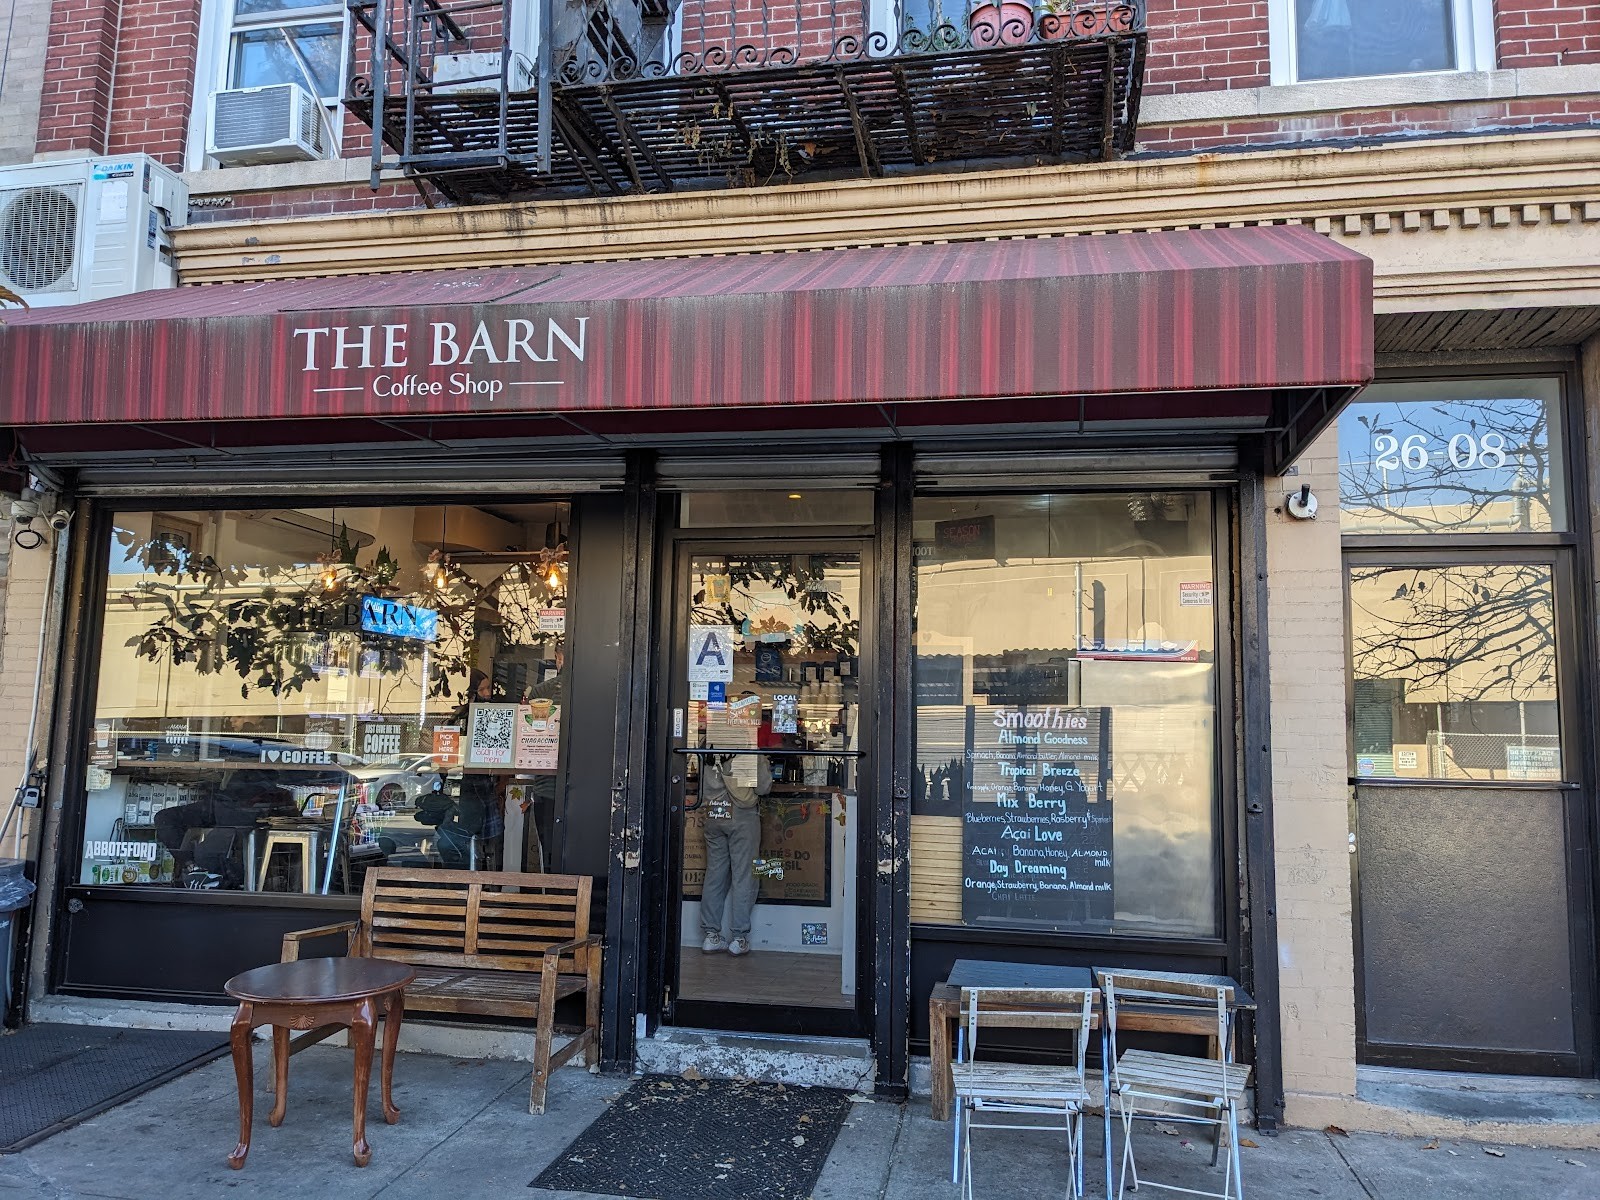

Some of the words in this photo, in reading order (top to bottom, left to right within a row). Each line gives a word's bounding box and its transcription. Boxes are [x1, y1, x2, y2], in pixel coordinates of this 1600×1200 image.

[101, 163, 133, 171] DAIKIN
[293, 323, 408, 371] THE
[429, 317, 590, 366] BARN
[372, 374, 443, 397] Coffee
[448, 372, 503, 402] Shop
[1374, 433, 1506, 471] 26-08
[343, 602, 418, 626] BARN
[695, 631, 726, 666] A
[993, 707, 1088, 729] Smoothies
[165, 736, 189, 744] COFFEE
[363, 733, 401, 754] COFFEE
[998, 729, 1040, 744] Almond
[1044, 732, 1088, 745] Goodness
[260, 750, 267, 763] I
[281, 750, 332, 764] COFFEE
[998, 762, 1036, 781] Tropical
[1042, 763, 1080, 777] Breeze
[996, 792, 1019, 808] Mix
[1028, 793, 1066, 815] Berry
[1034, 826, 1063, 842] Love
[84, 840, 157, 862] ABBOTSFORD
[1071, 849, 1108, 857] ALMOND
[989, 859, 1009, 877] Day
[1014, 860, 1067, 880] Dreaming
[1094, 858, 1111, 867] milk
